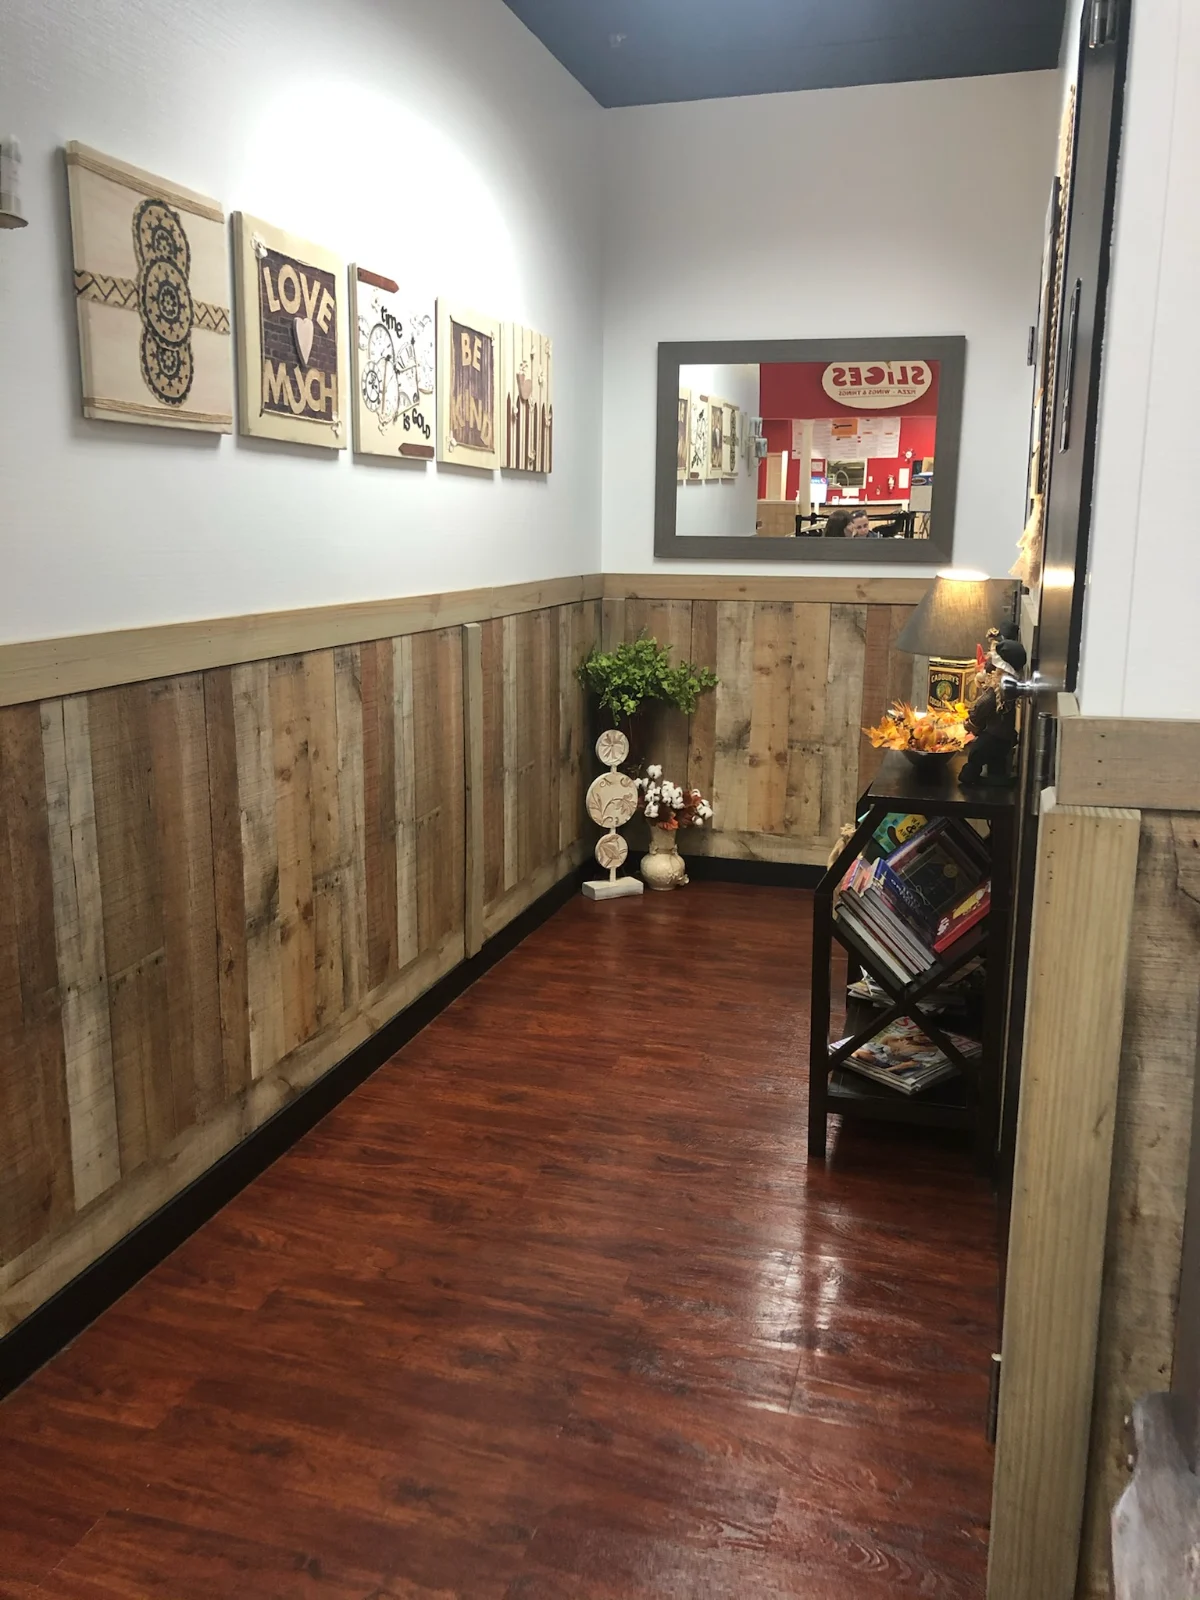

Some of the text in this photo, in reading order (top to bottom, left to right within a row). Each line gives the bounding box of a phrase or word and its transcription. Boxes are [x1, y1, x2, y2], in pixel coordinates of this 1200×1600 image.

[263, 264, 335, 334] LOVE
[380, 305, 403, 339] time
[460, 332, 482, 372] BE
[263, 359, 337, 415] MUCH
[403, 408, 431, 440] is GOLD
[450, 388, 491, 446] KIND
